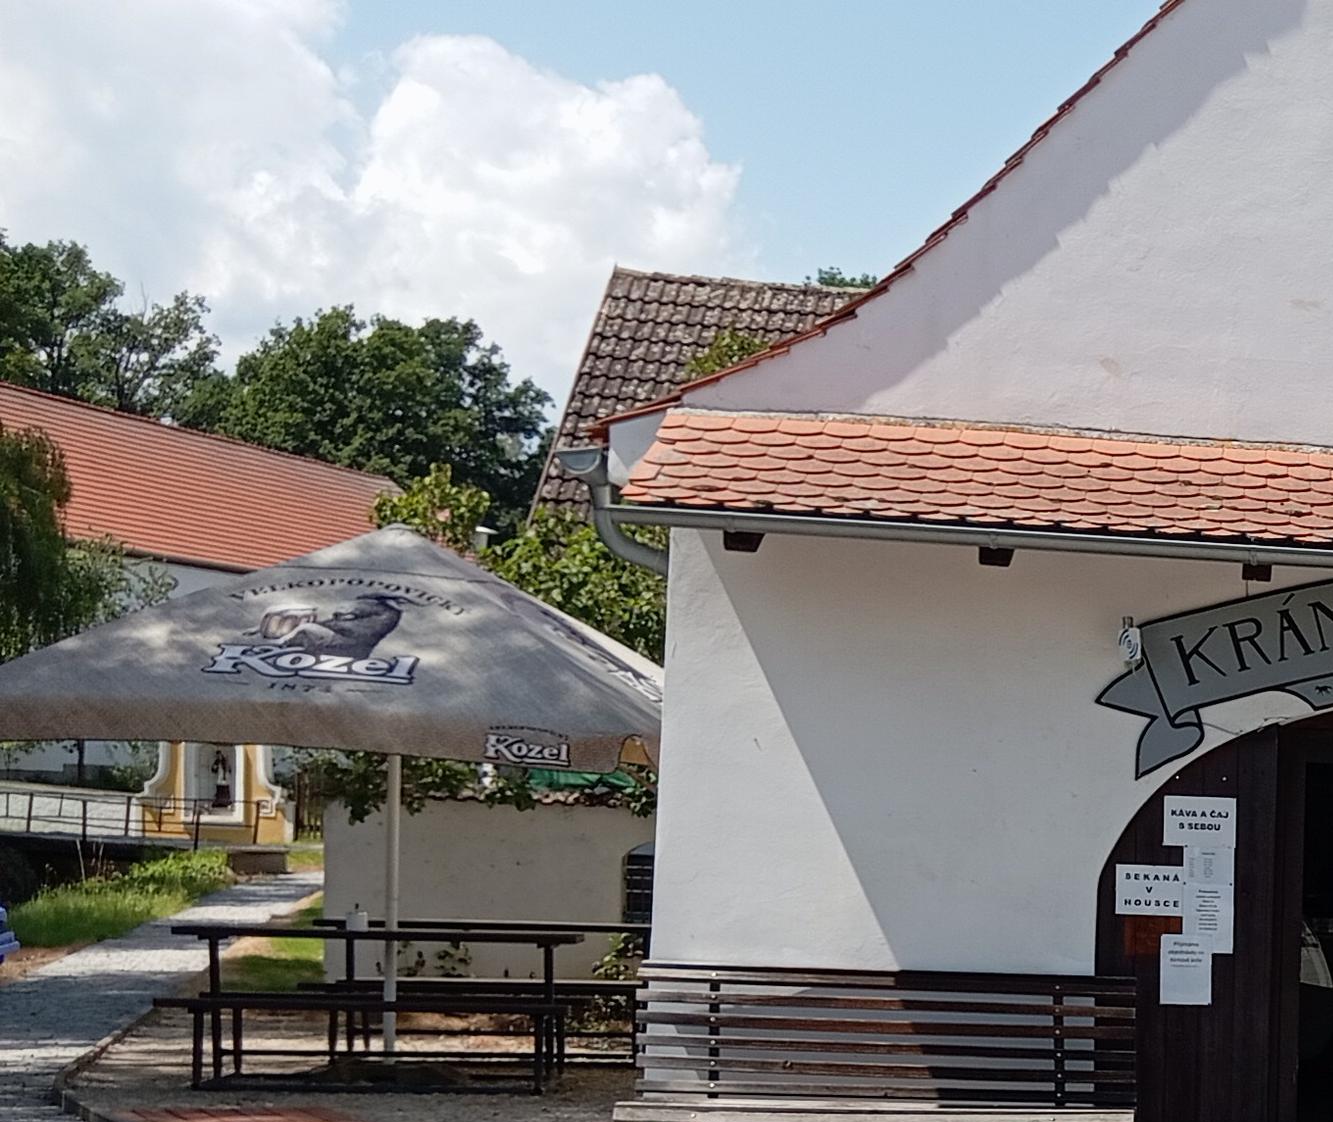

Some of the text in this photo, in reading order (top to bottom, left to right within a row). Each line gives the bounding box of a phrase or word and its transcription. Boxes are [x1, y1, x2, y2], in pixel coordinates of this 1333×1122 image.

[201, 643, 421, 686] Kozel
[483, 732, 571, 768] Kozel
[1170, 808, 1229, 819] KÁVA A ČAJ
[1187, 823, 1221, 831] SEBOU
[1124, 899, 1180, 908] HOUSCE
